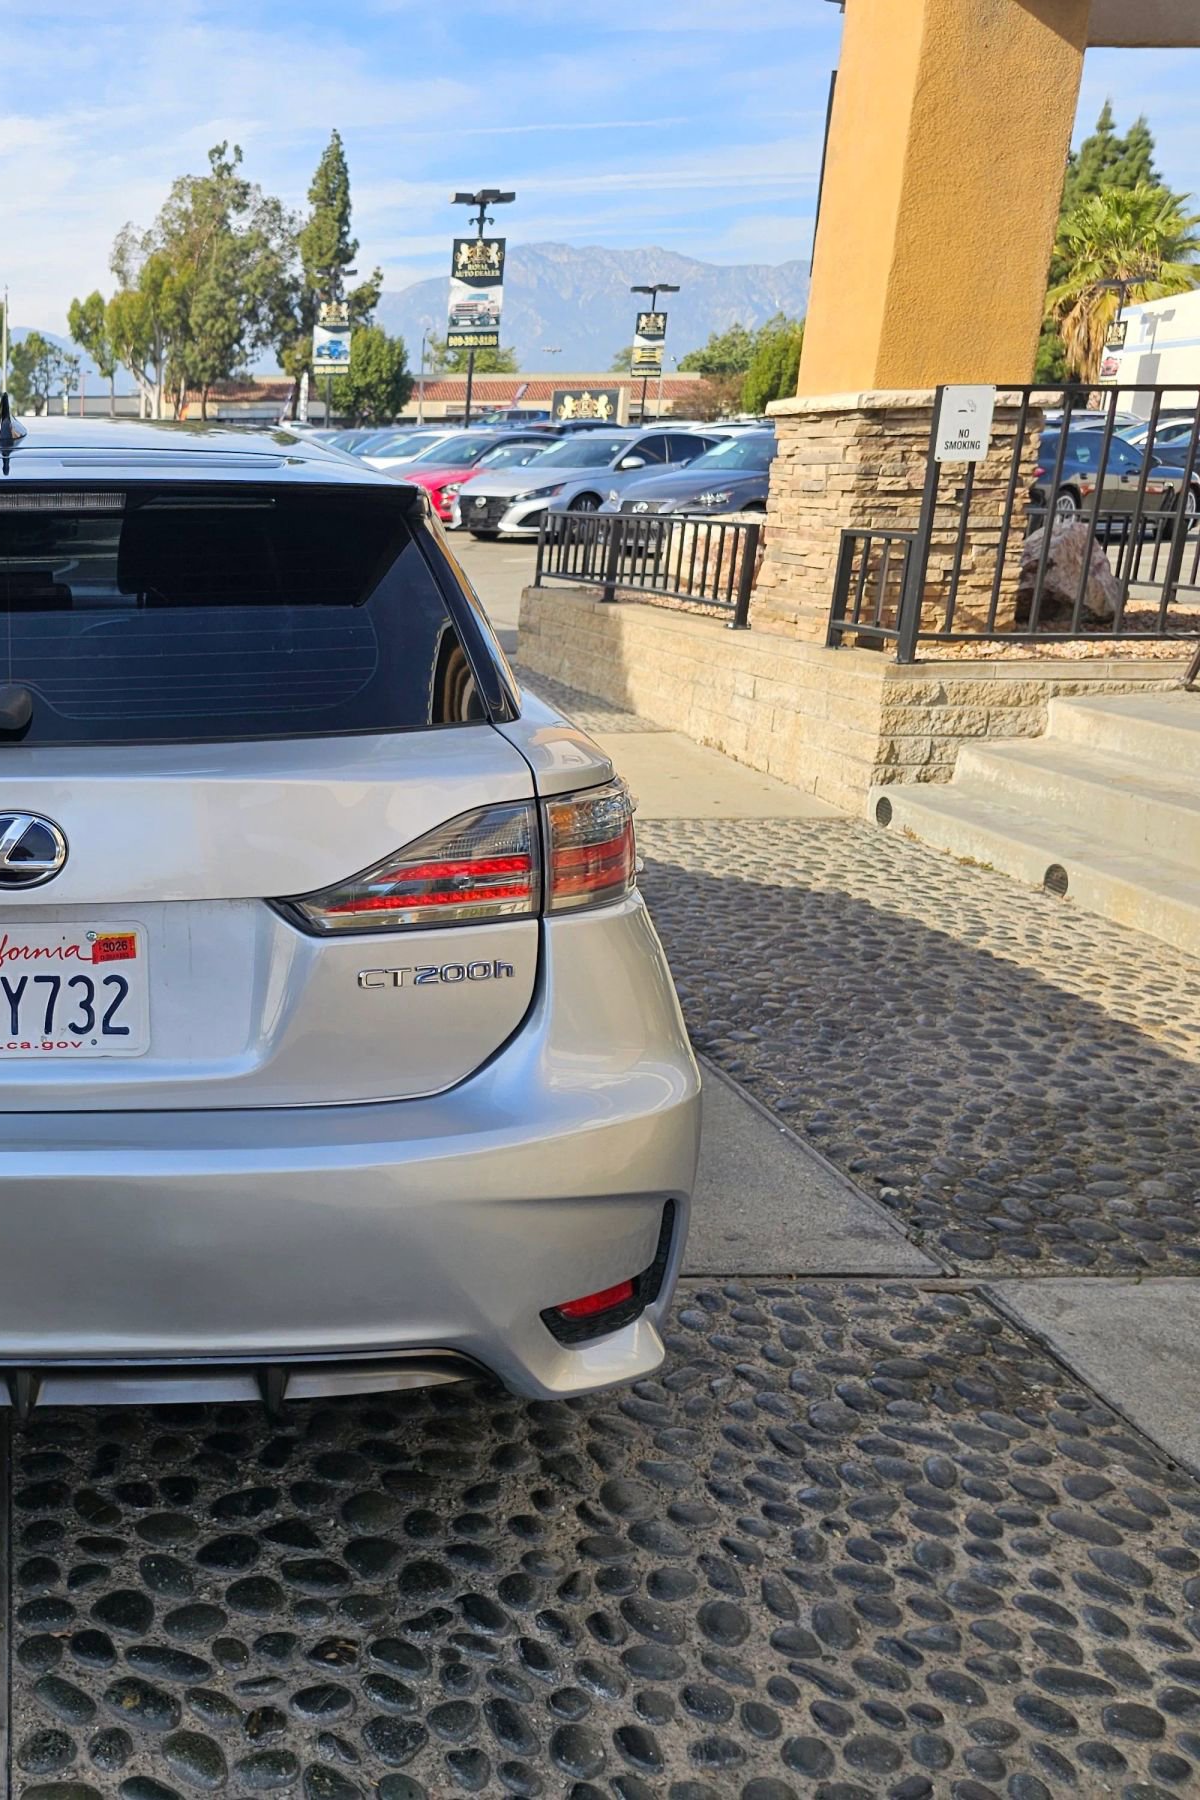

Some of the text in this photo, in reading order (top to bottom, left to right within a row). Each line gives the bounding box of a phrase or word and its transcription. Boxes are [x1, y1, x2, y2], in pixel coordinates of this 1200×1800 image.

[958, 428, 970, 439] NO
[944, 440, 981, 450] SMOKING
[103, 940, 128, 952] 2026
